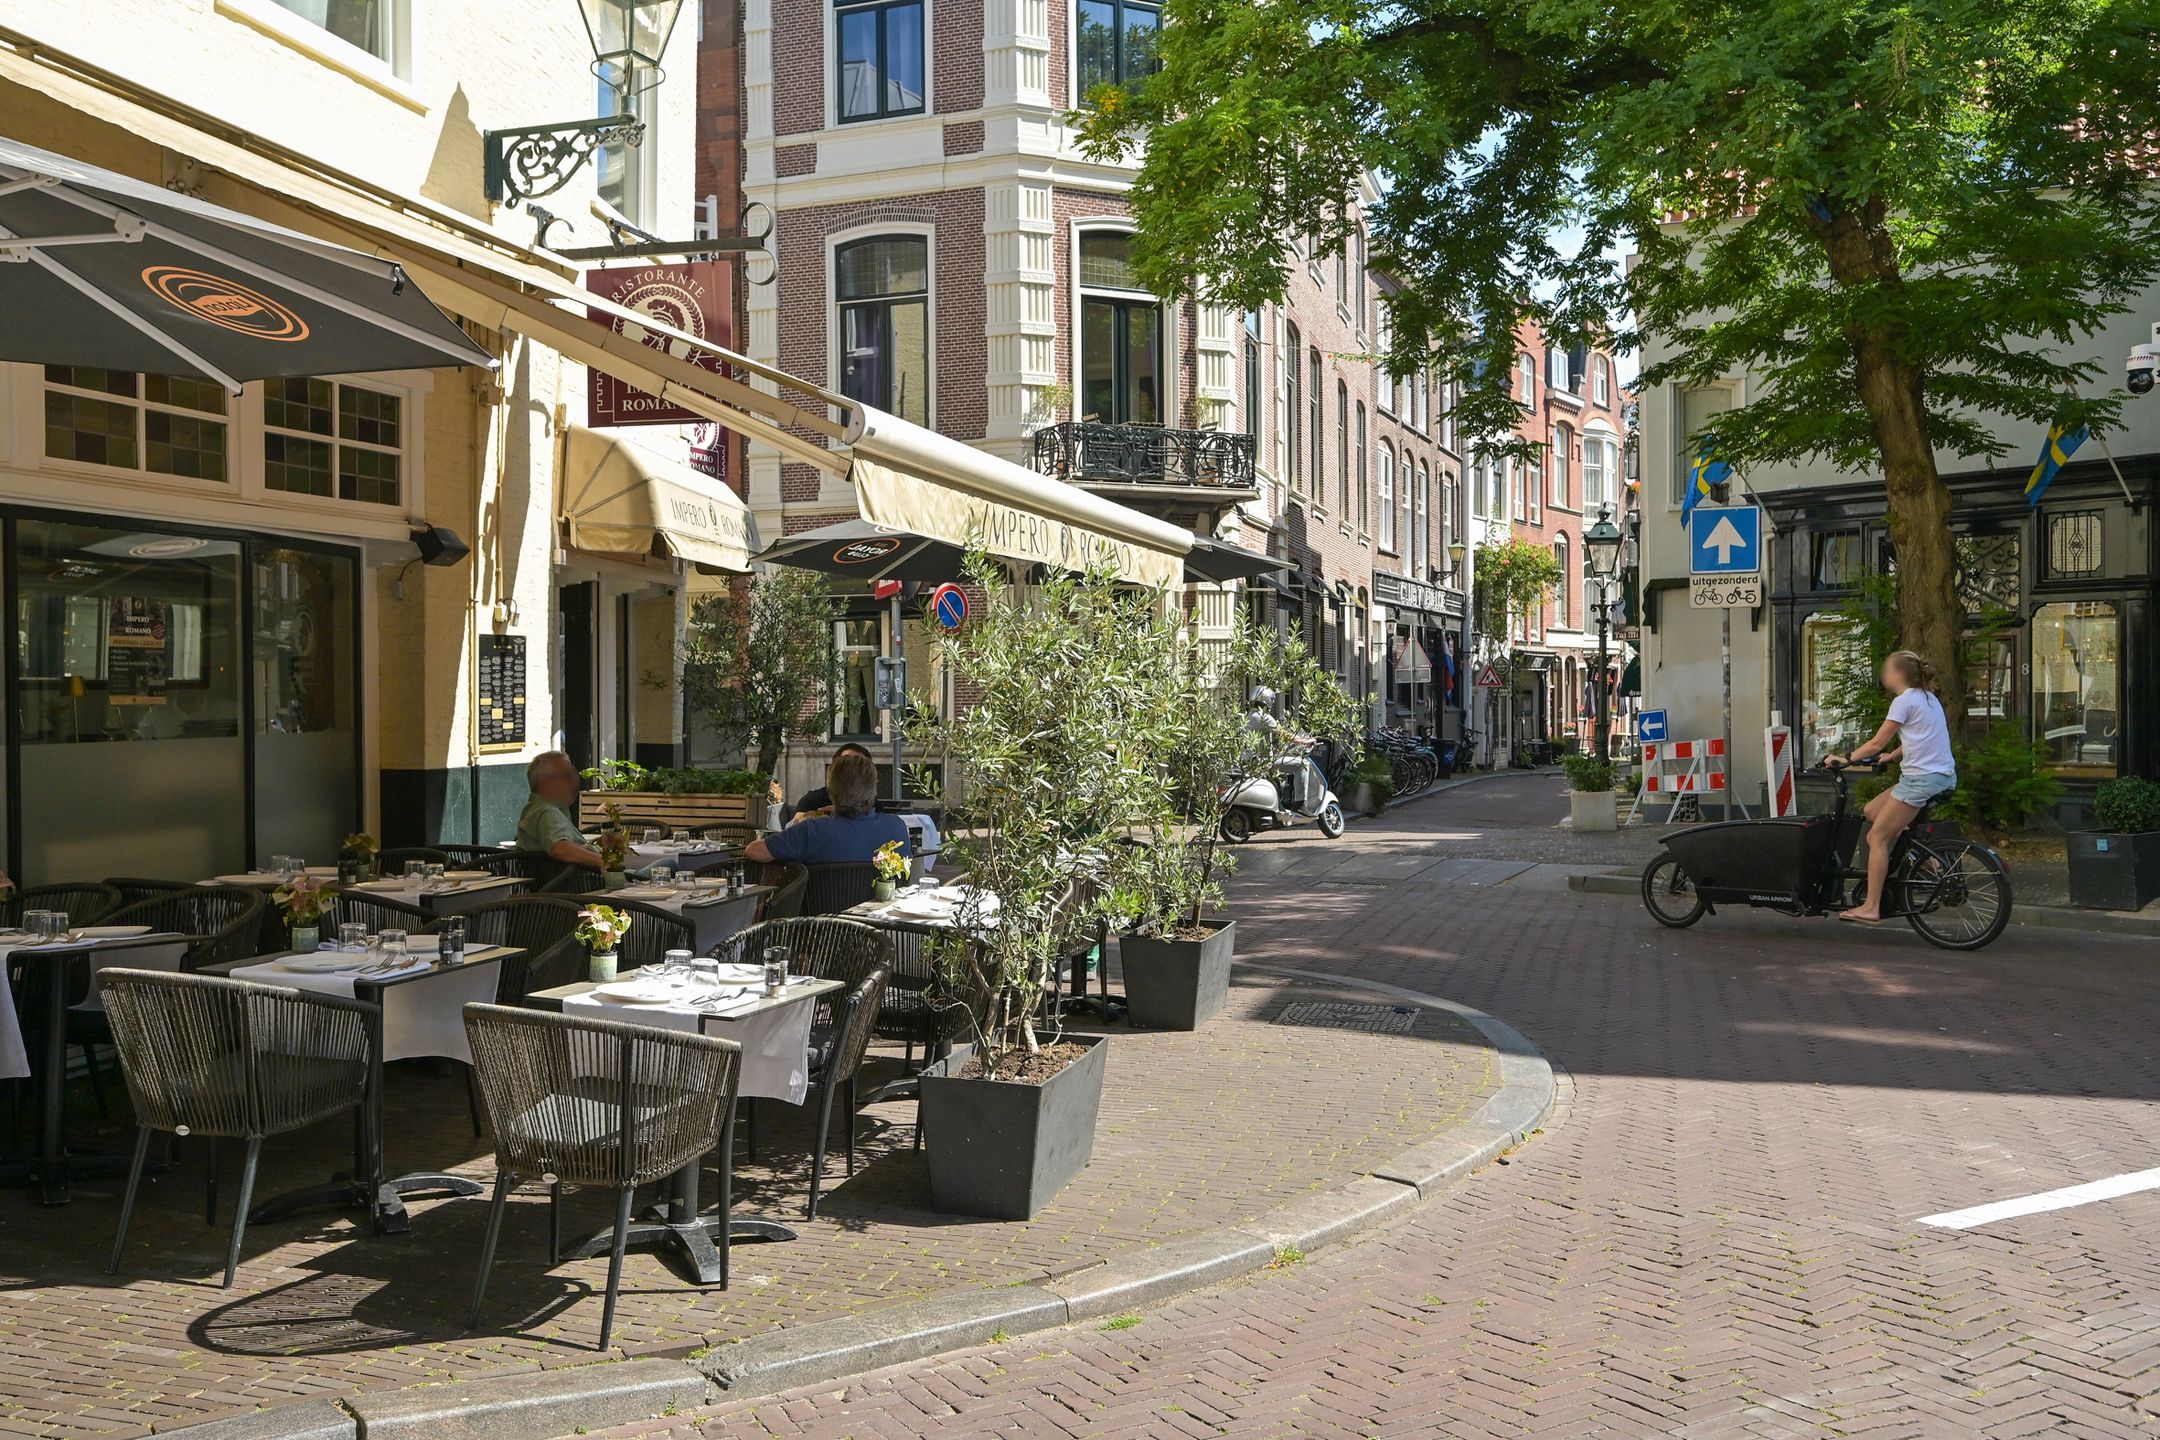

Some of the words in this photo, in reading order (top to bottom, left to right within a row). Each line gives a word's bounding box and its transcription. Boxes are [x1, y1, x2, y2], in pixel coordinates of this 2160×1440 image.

[611, 269, 706, 303] RISTORANTE
[622, 398, 683, 411] ROMA
[690, 451, 714, 464] MPERO
[690, 461, 715, 474] OMANO
[670, 497, 707, 529] IMPERO
[982, 503, 1050, 557] IMPERO
[1692, 575, 1759, 587] uitgezonderd
[126, 615, 150, 623] IMPERO
[2021, 663, 2030, 676] 8
[1770, 895, 1793, 903] ARROW
